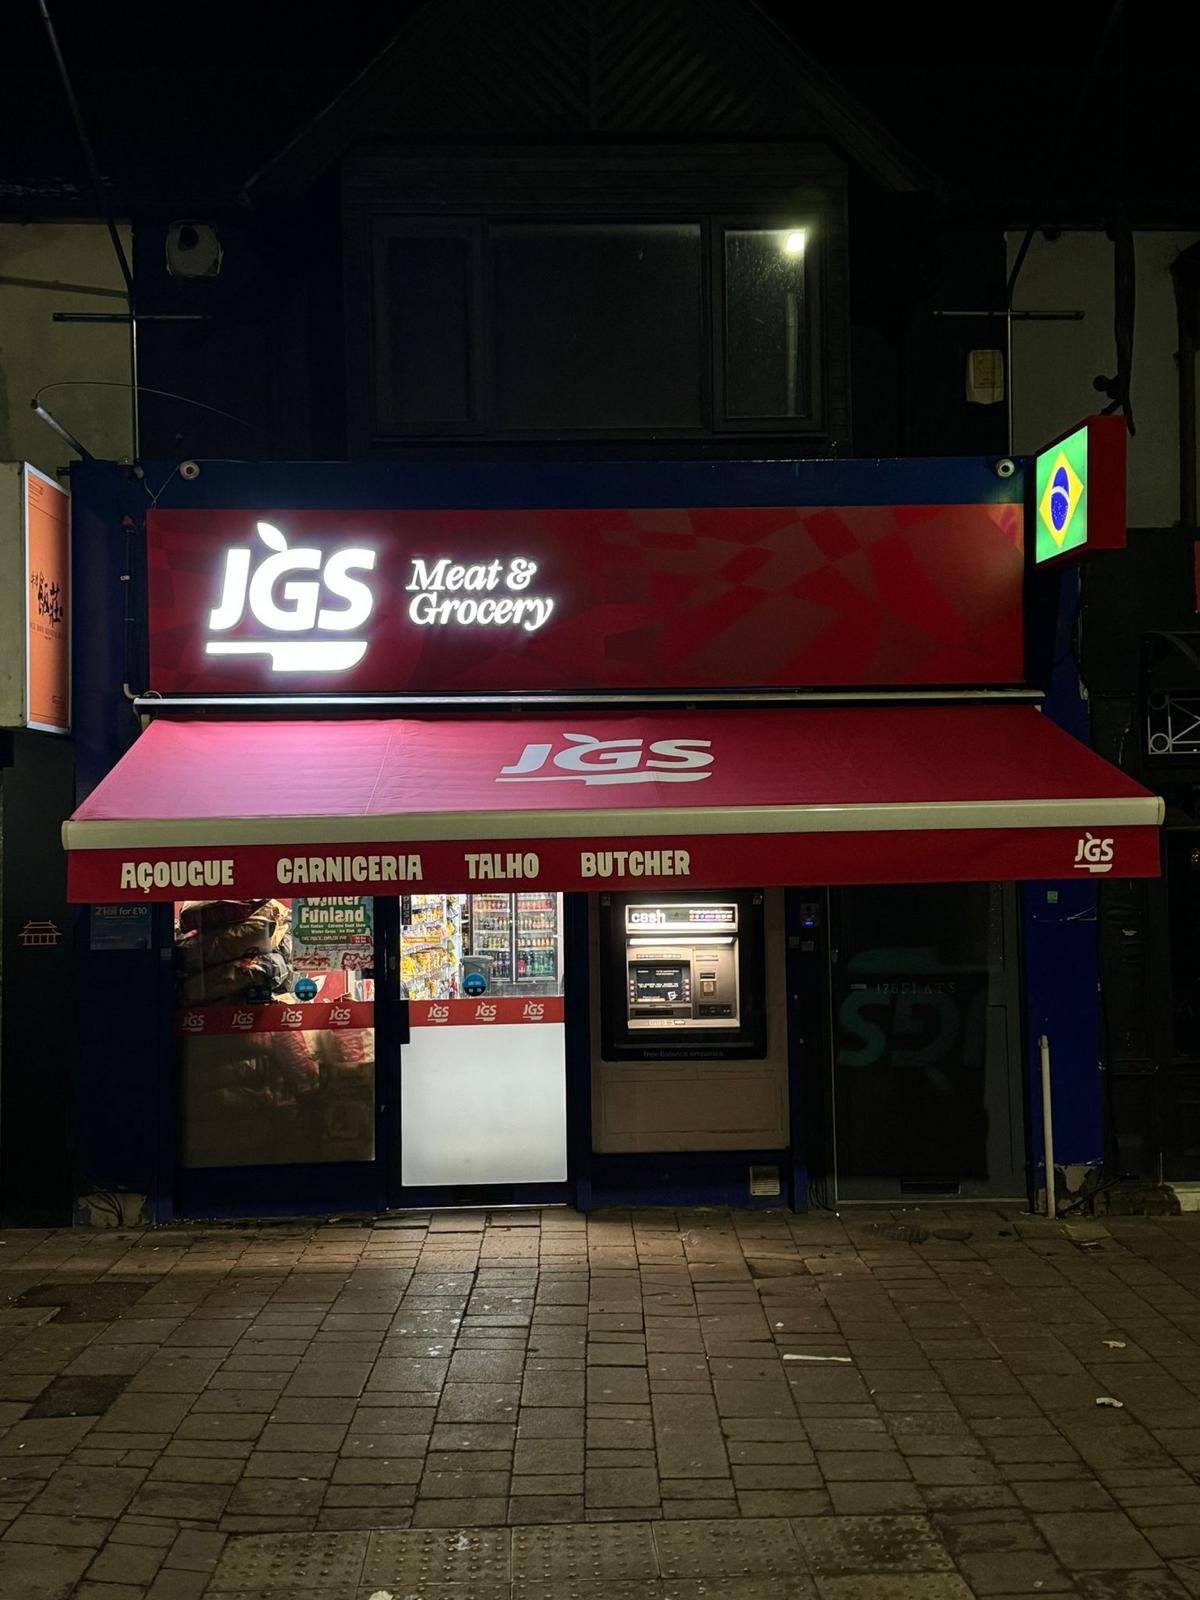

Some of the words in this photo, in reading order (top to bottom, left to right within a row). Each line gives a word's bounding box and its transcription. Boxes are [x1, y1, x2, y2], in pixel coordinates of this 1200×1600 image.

[208, 522, 377, 631] JGS
[405, 558, 503, 591] Meat
[506, 557, 538, 590] &
[407, 591, 554, 632] Grocery
[499, 733, 715, 774] JGS
[1074, 832, 1114, 862] JGS
[120, 859, 235, 893] AÇOUGUE
[276, 854, 424, 884] CARNICERIA
[464, 852, 540, 879] TALHO
[580, 850, 691, 877] BUTCHER
[301, 906, 365, 923] Funland
[631, 909, 666, 923] cash
[183, 1012, 205, 1027] JGS
[231, 1010, 254, 1025] JGS
[281, 1008, 303, 1023] JGS
[329, 1006, 351, 1021] JGS
[427, 1003, 449, 1018] JGS
[475, 1002, 497, 1016] JGS
[523, 1001, 545, 1015] JGS
